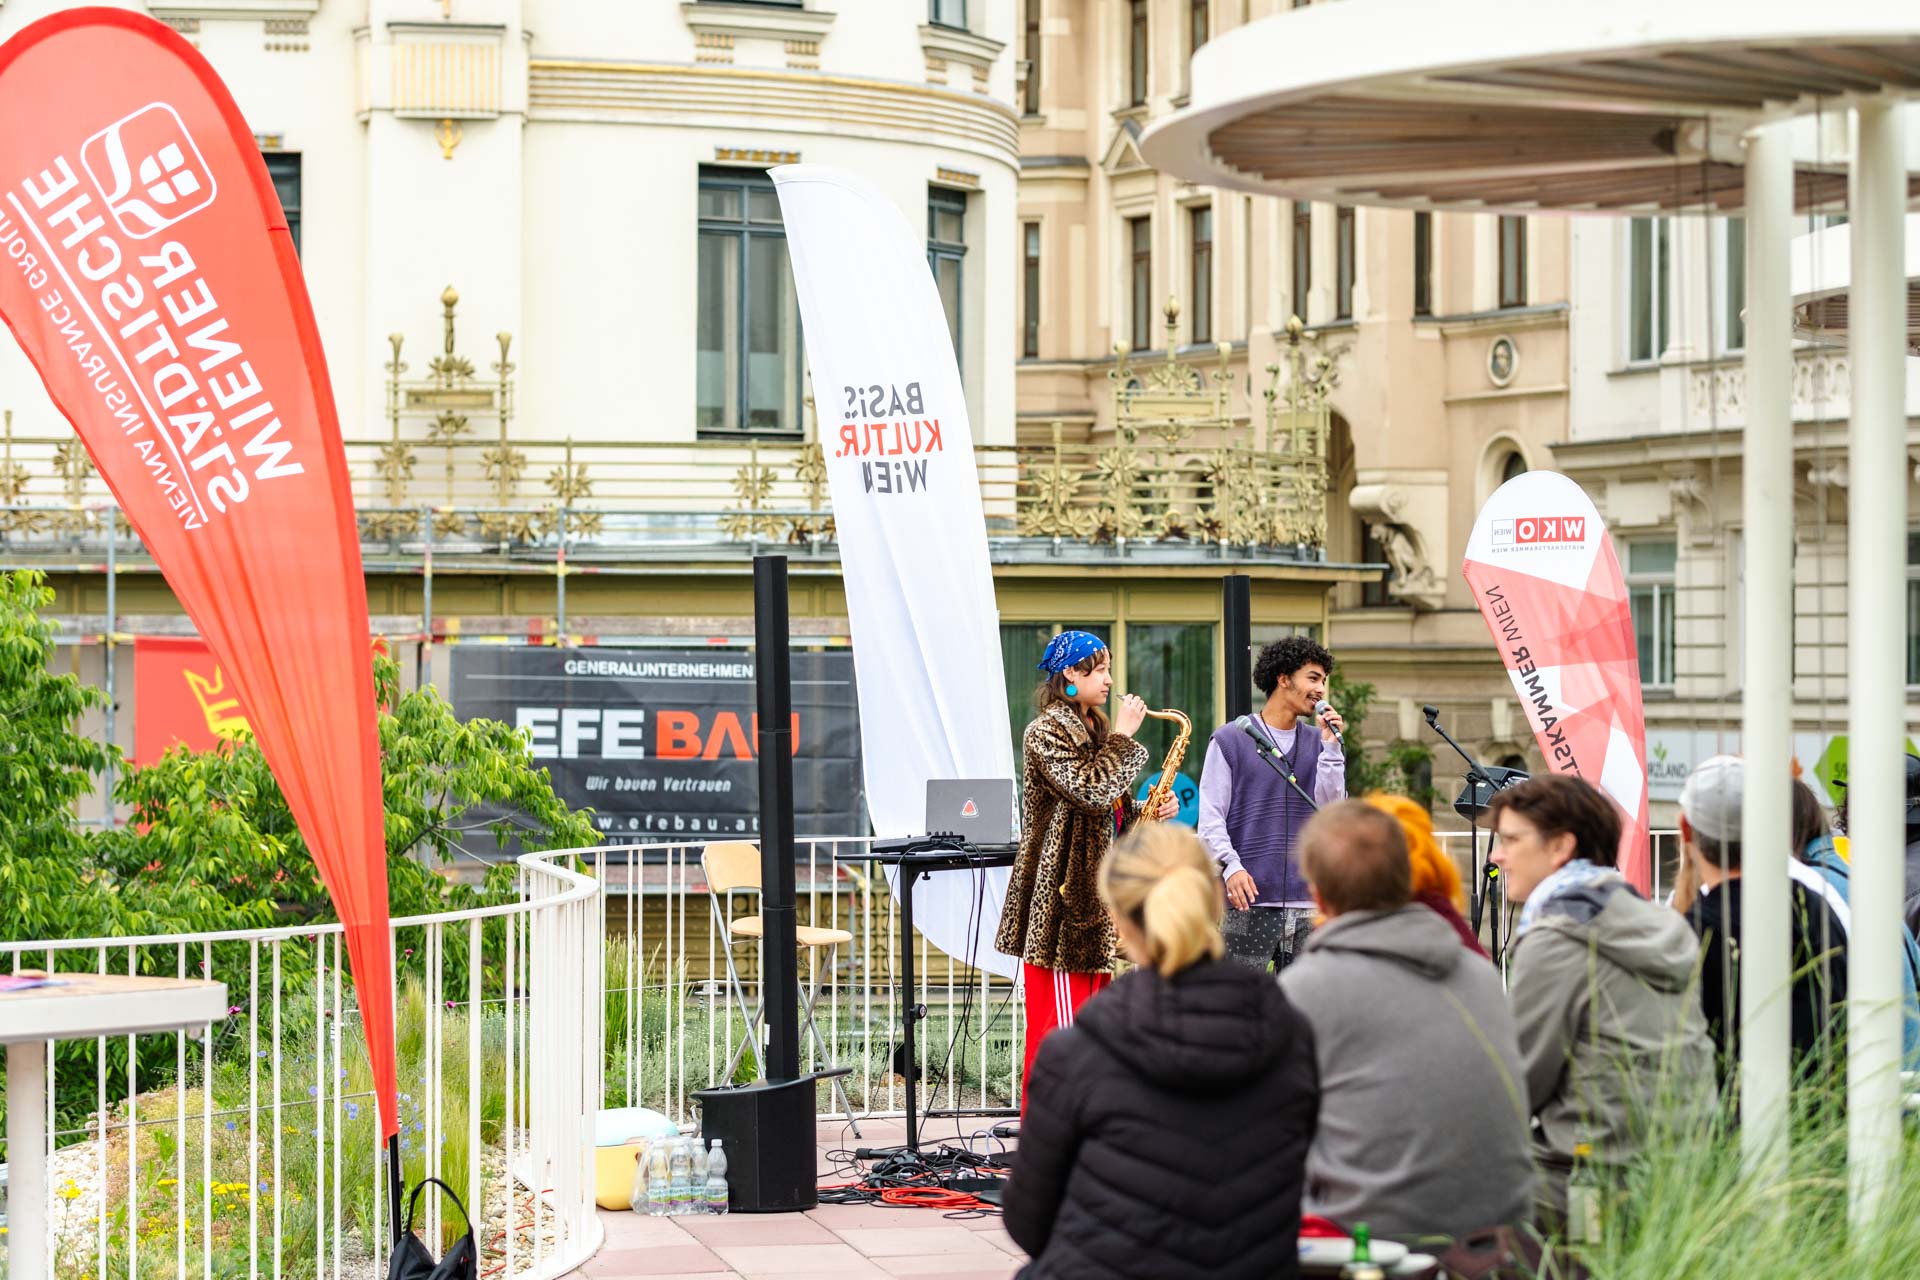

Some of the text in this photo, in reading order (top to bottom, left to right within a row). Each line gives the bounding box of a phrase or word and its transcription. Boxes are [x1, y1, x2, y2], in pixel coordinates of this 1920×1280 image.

[564, 660, 753, 678] GENERALUNTERNEHMEN
[515, 707, 645, 760] EFE
[585, 776, 731, 793] Wir bauen Vertrauen
[598, 814, 759, 831] w.efebau.at
